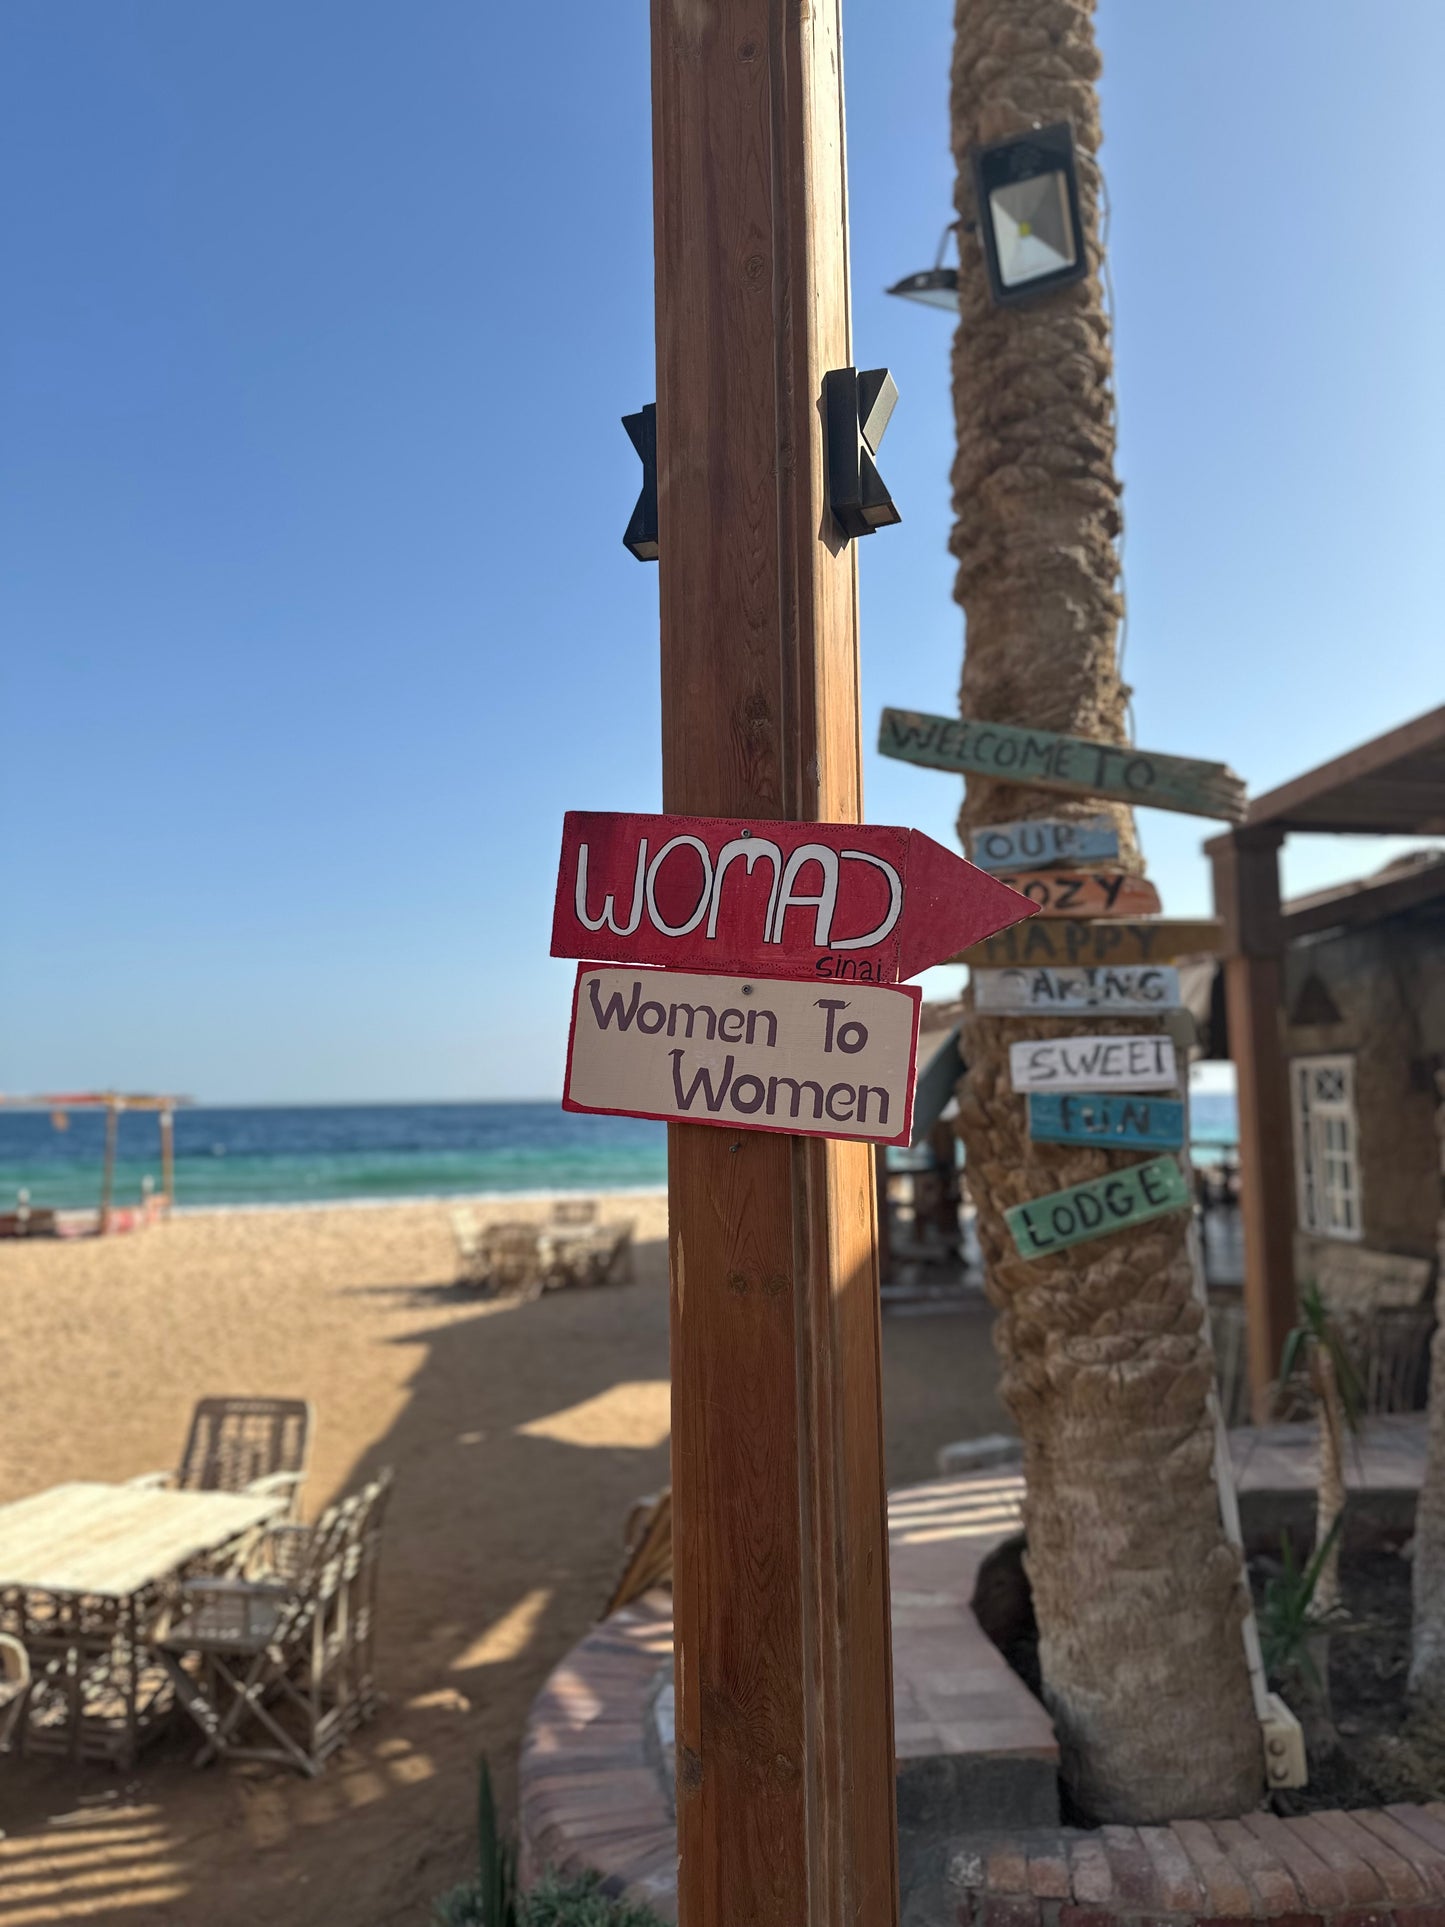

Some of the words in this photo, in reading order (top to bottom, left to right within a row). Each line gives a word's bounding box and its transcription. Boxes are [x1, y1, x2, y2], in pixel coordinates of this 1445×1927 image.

[889, 717, 1074, 779] WELCOME
[1086, 745, 1156, 790] TO
[574, 834, 903, 950] WOMAD
[587, 978, 778, 1048] Women
[813, 999, 869, 1055] To
[668, 1049, 890, 1125] Women
[1029, 1039, 1173, 1081] SWEET
[1022, 1166, 1171, 1249] LODGE
